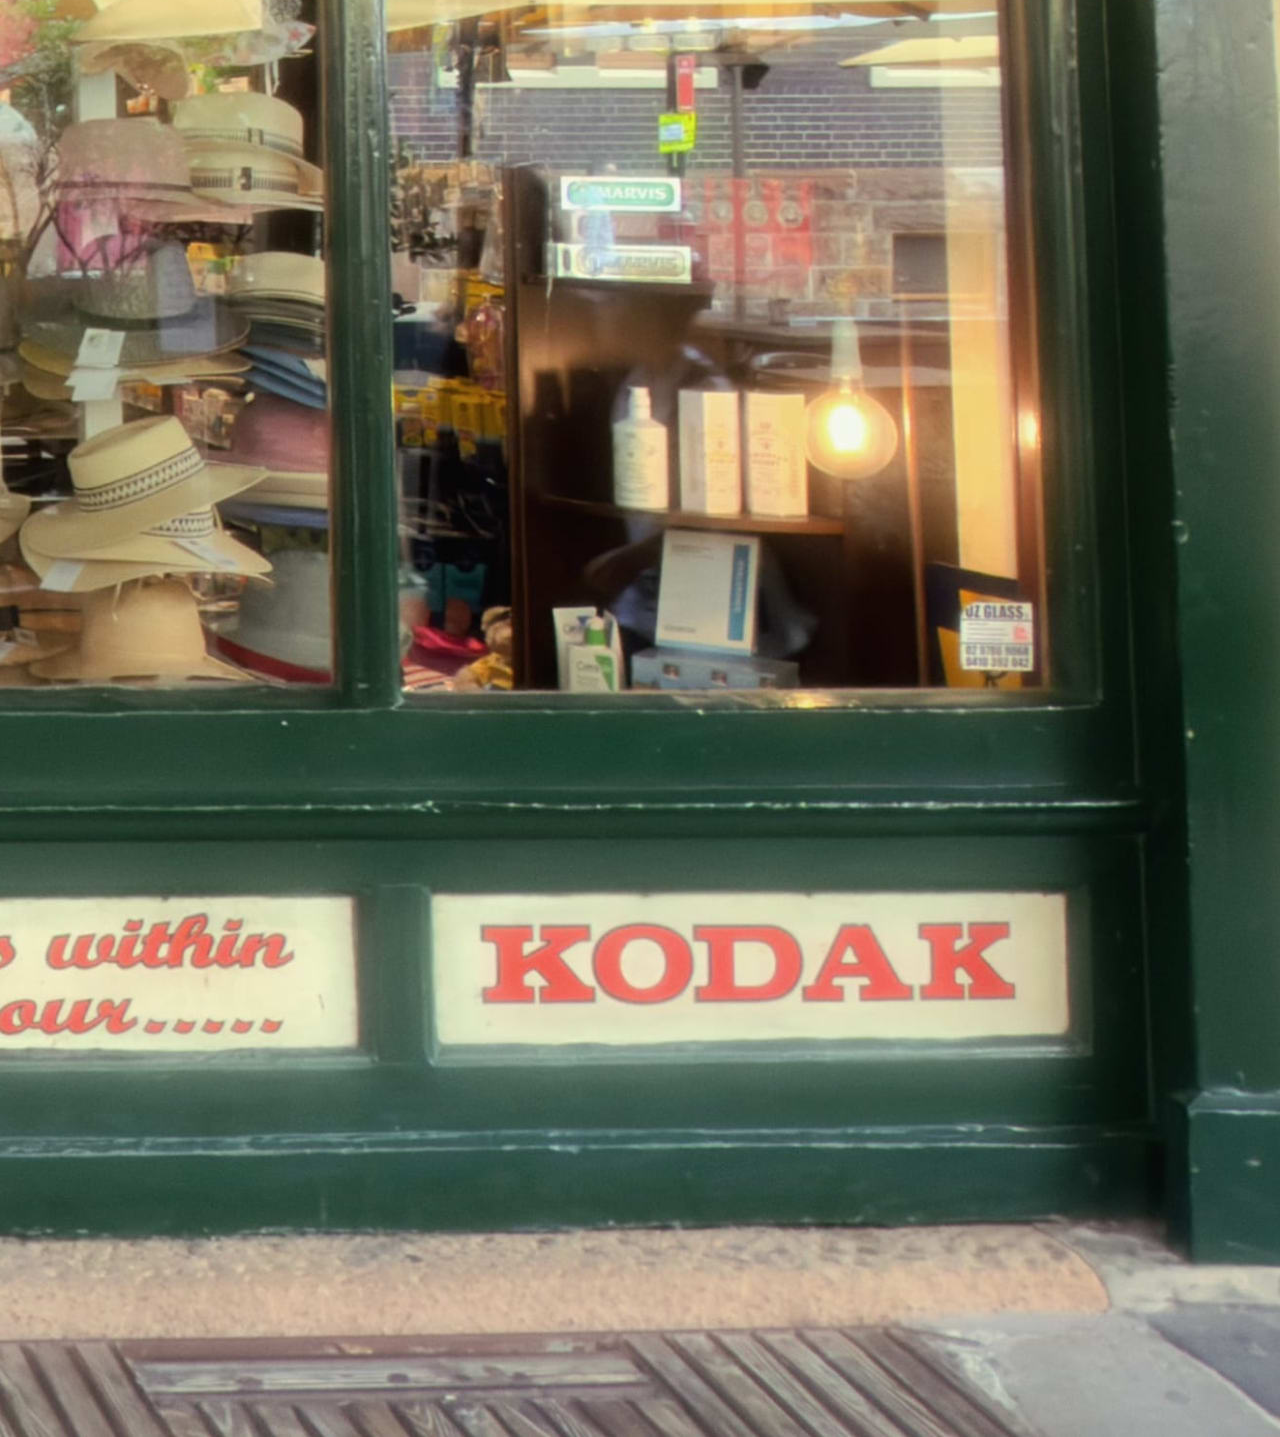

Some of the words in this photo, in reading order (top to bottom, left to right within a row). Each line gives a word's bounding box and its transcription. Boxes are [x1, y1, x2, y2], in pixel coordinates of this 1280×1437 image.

[983, 605, 1024, 619] GLASS
[45, 913, 295, 972] within
[479, 922, 1017, 1005] KODAK
